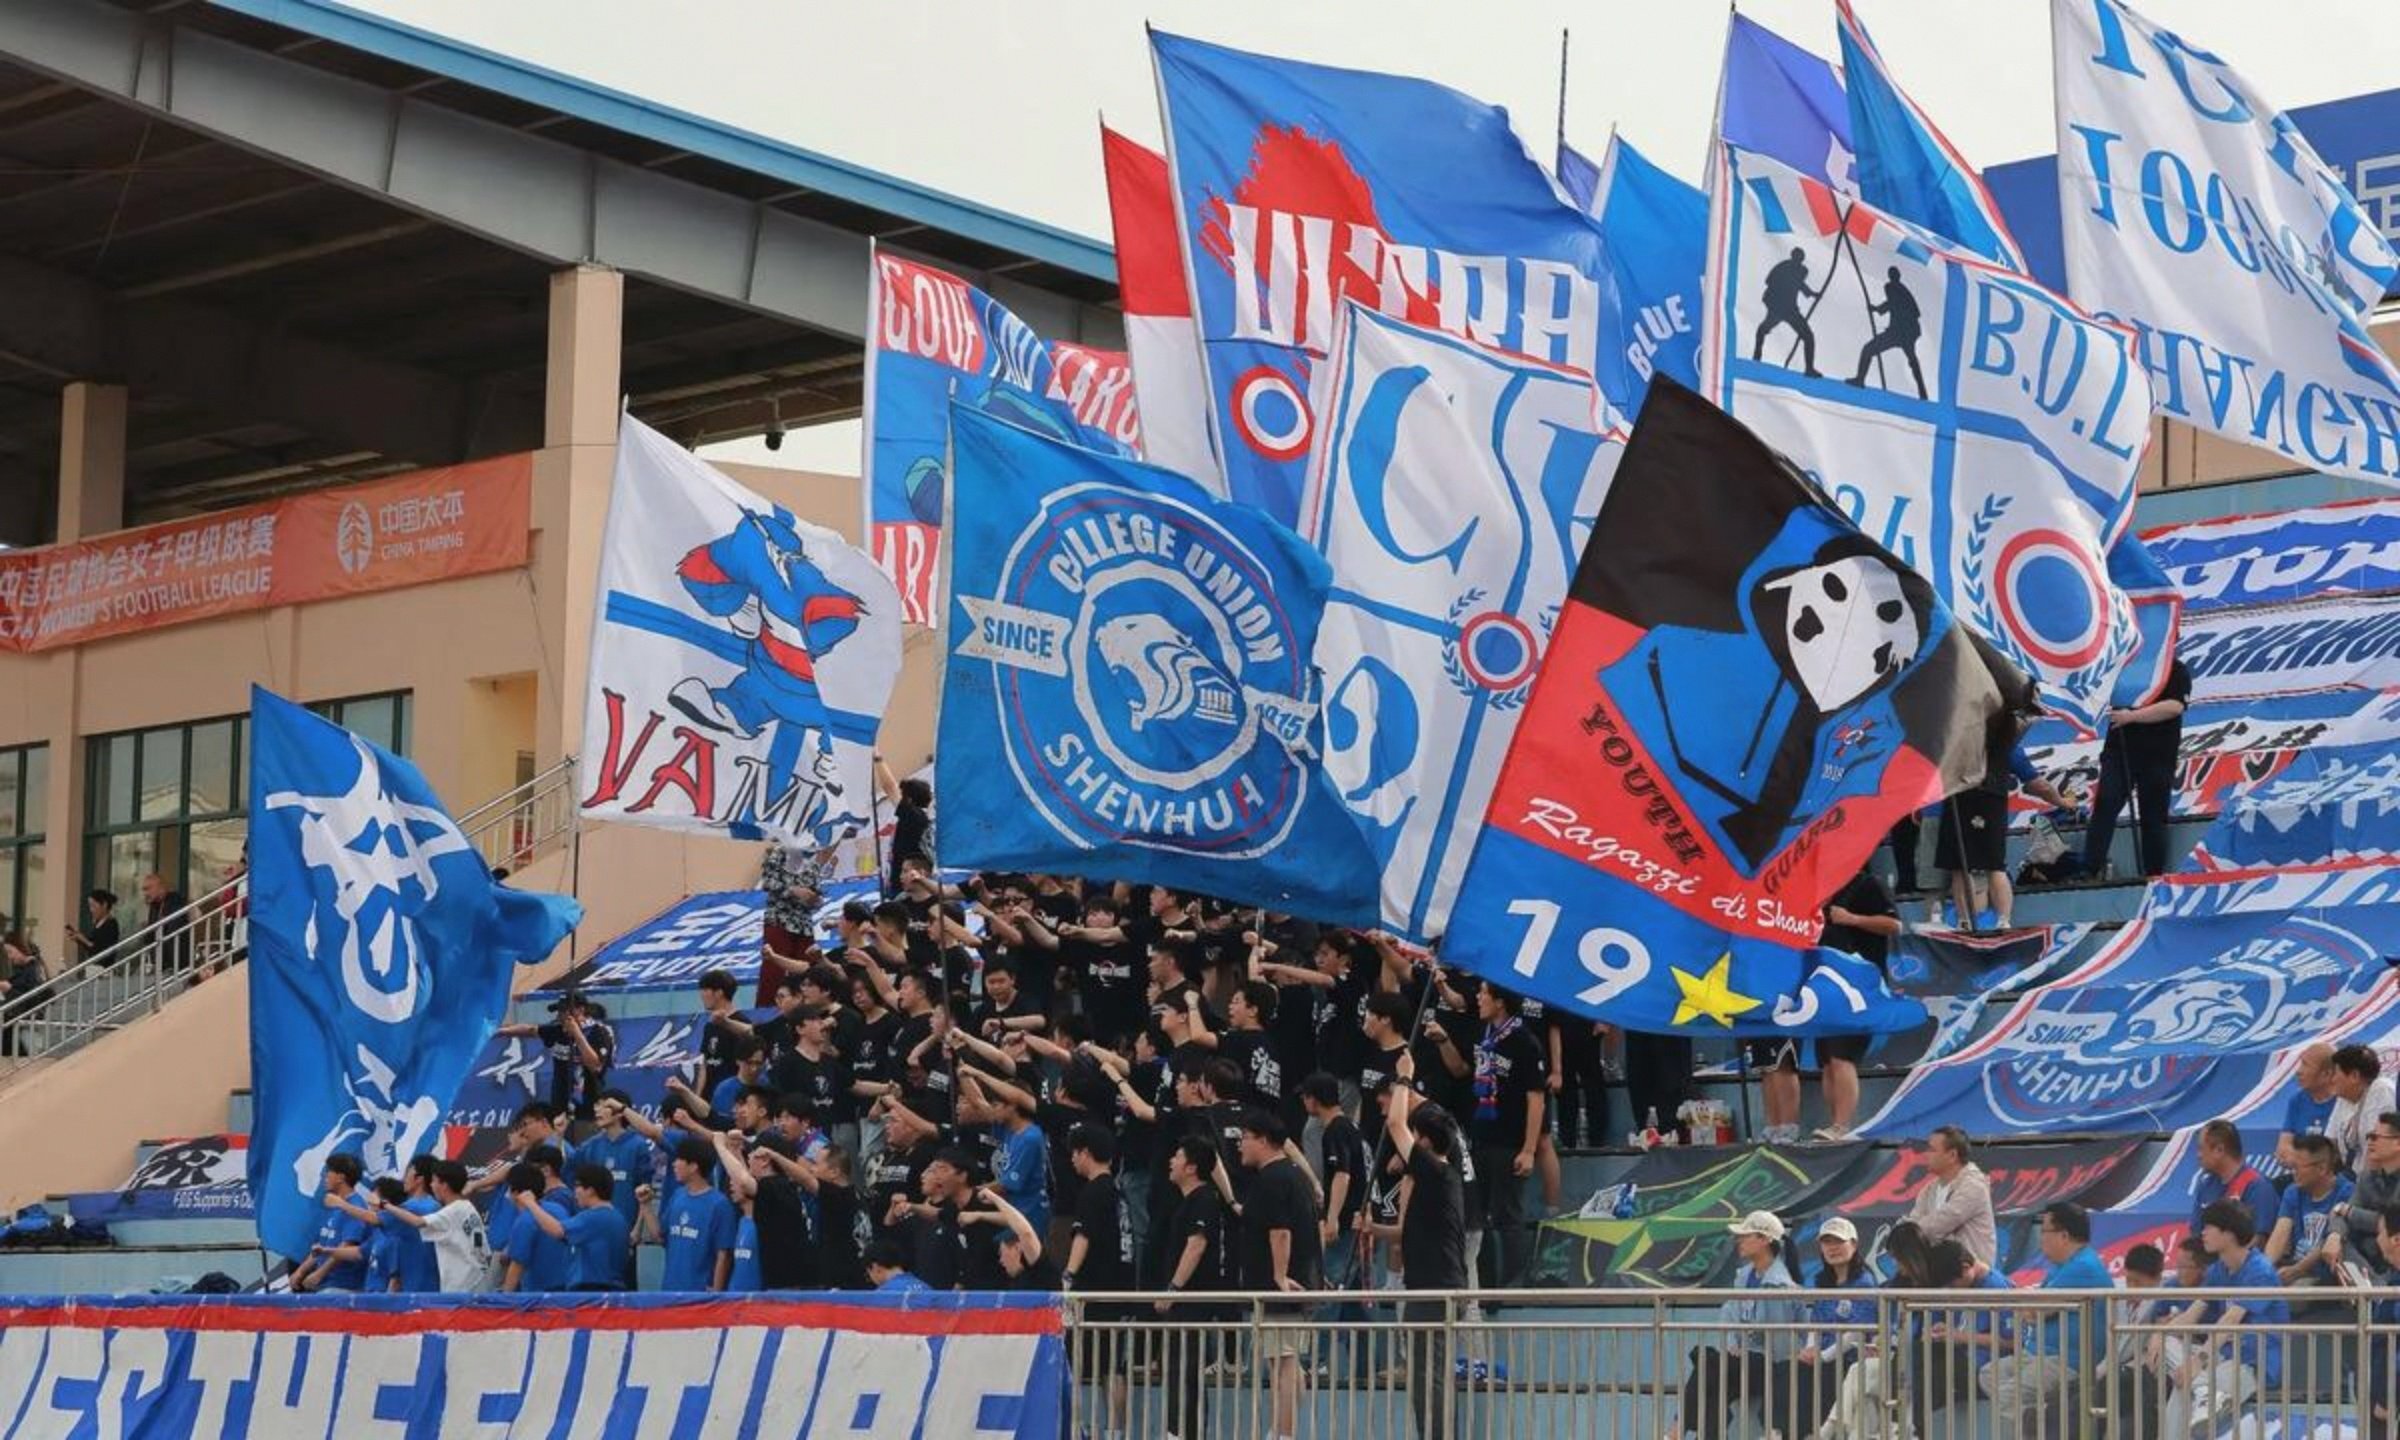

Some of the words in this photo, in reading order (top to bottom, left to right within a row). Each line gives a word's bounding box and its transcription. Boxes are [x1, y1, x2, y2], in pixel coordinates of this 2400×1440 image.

[1627, 294, 1692, 383] BLUE
[379, 489, 465, 536] 中国太平
[115, 583, 196, 618] FOOTBALL
[203, 566, 273, 600] LEAGUE
[1184, 542, 1284, 663] UNION
[983, 615, 1053, 659] SINCE
[1580, 703, 1708, 866] YOUTH
[1520, 796, 1702, 896] Ragazzi
[1711, 892, 1748, 920] di
[1506, 899, 1652, 1006] 19
[2027, 1022, 2096, 1045] SINCE
